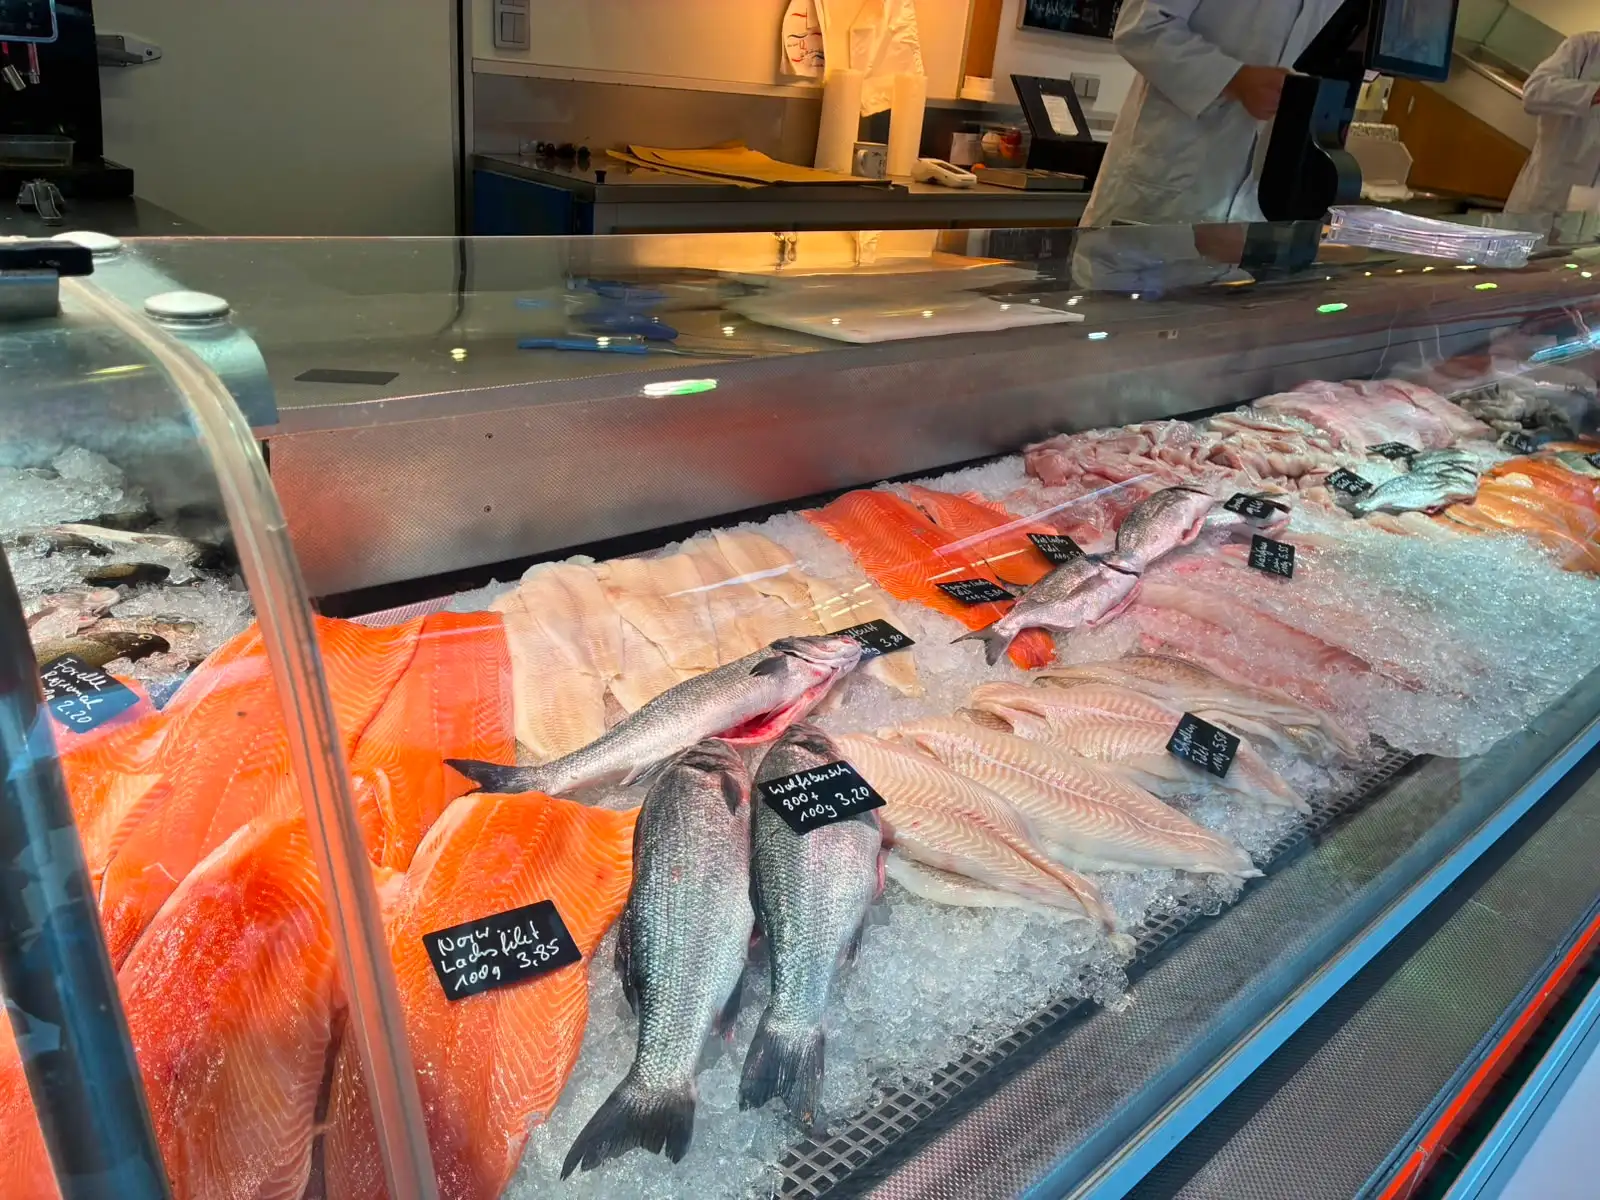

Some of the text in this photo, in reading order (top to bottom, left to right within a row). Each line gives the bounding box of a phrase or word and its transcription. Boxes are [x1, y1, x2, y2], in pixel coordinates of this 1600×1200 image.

[56, 700, 93, 724] 2,20
[799, 785, 870, 823] 100g 3,20
[453, 937, 560, 992] 100g 3,85
